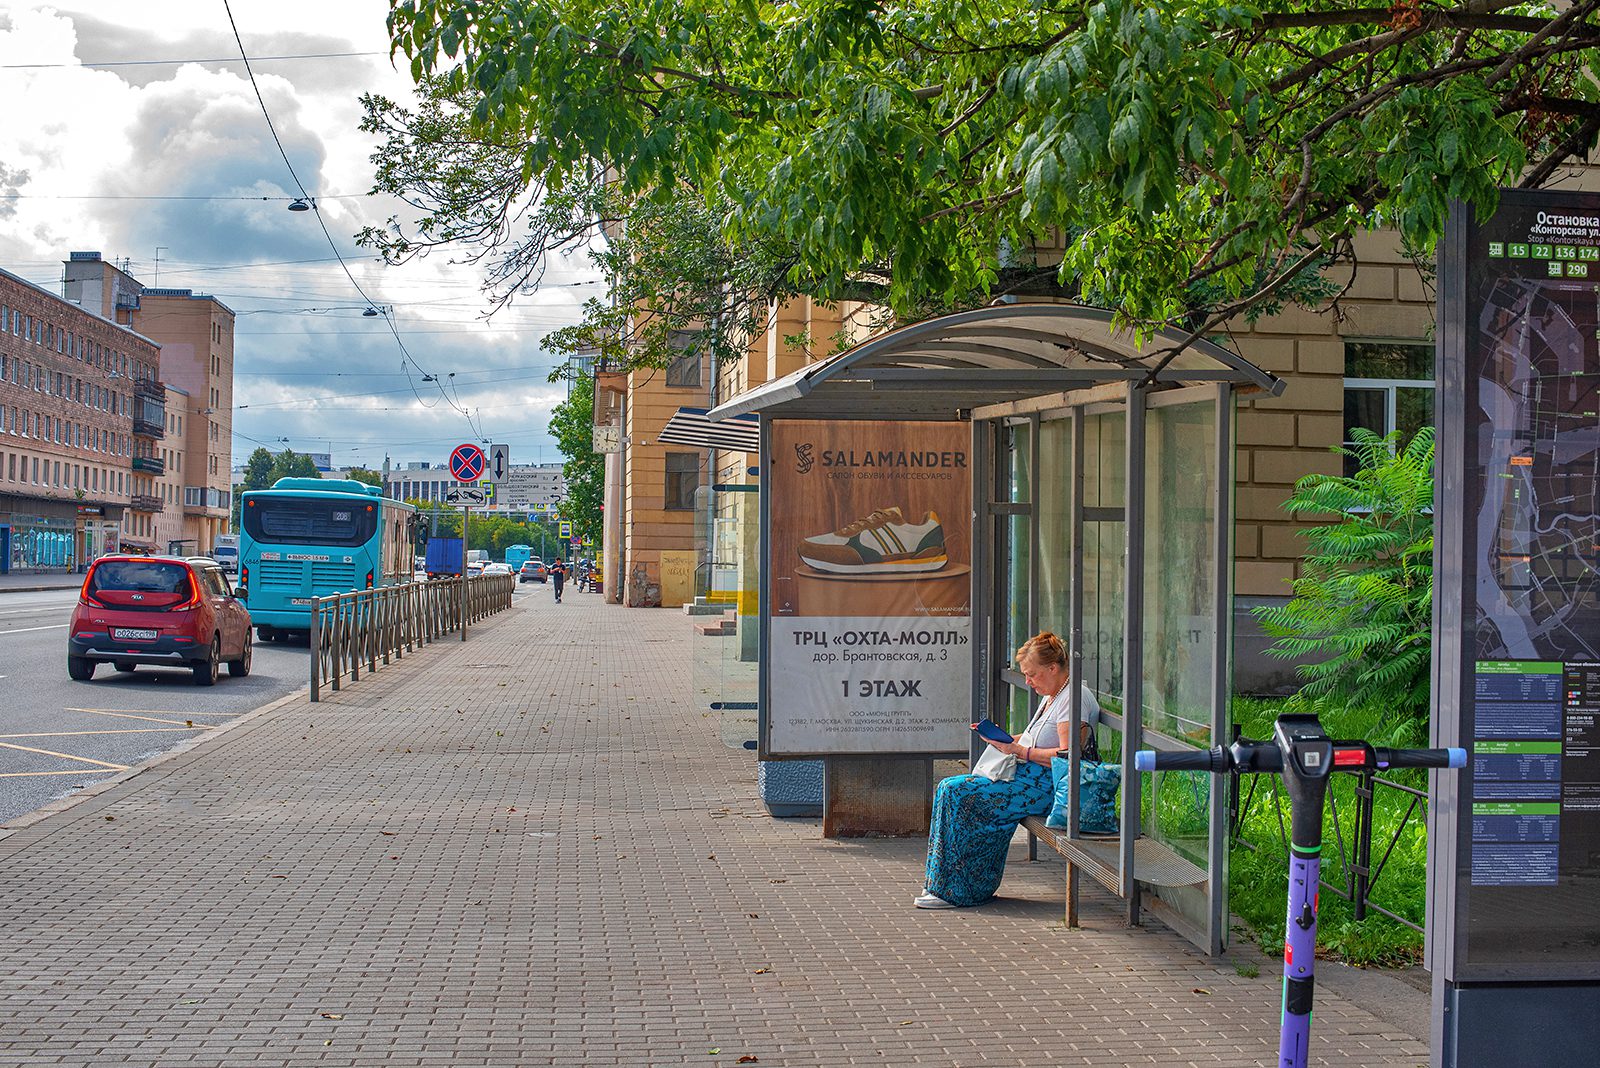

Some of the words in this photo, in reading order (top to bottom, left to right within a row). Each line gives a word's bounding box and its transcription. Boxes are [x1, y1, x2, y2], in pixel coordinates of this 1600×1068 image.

[1537, 211, 1600, 227] Остановка
[1530, 224, 1586, 236] «Конторская
[1528, 234, 1544, 244] Stop
[1546, 236, 1593, 246] «Kontorskaya
[1512, 245, 1525, 256] 15
[1536, 247, 1549, 257] 22
[1557, 248, 1576, 258] 136
[1580, 249, 1599, 259] 174
[1568, 264, 1587, 275] 290
[822, 450, 967, 468] SALAMANDER
[827, 472, 854, 480] САЛОН
[857, 472, 885, 480] ОБУВИ
[887, 472, 894, 480] И
[793, 631, 828, 648] ТРЦ
[832, 631, 968, 646] «ОХТА-МОЛЛ»
[812, 654, 839, 664] дор.
[843, 649, 923, 664] Брантовская,
[925, 652, 937, 663] д.
[940, 649, 948, 661] 3
[842, 680, 849, 697] 1
[859, 680, 922, 697] ЭТАЖ
